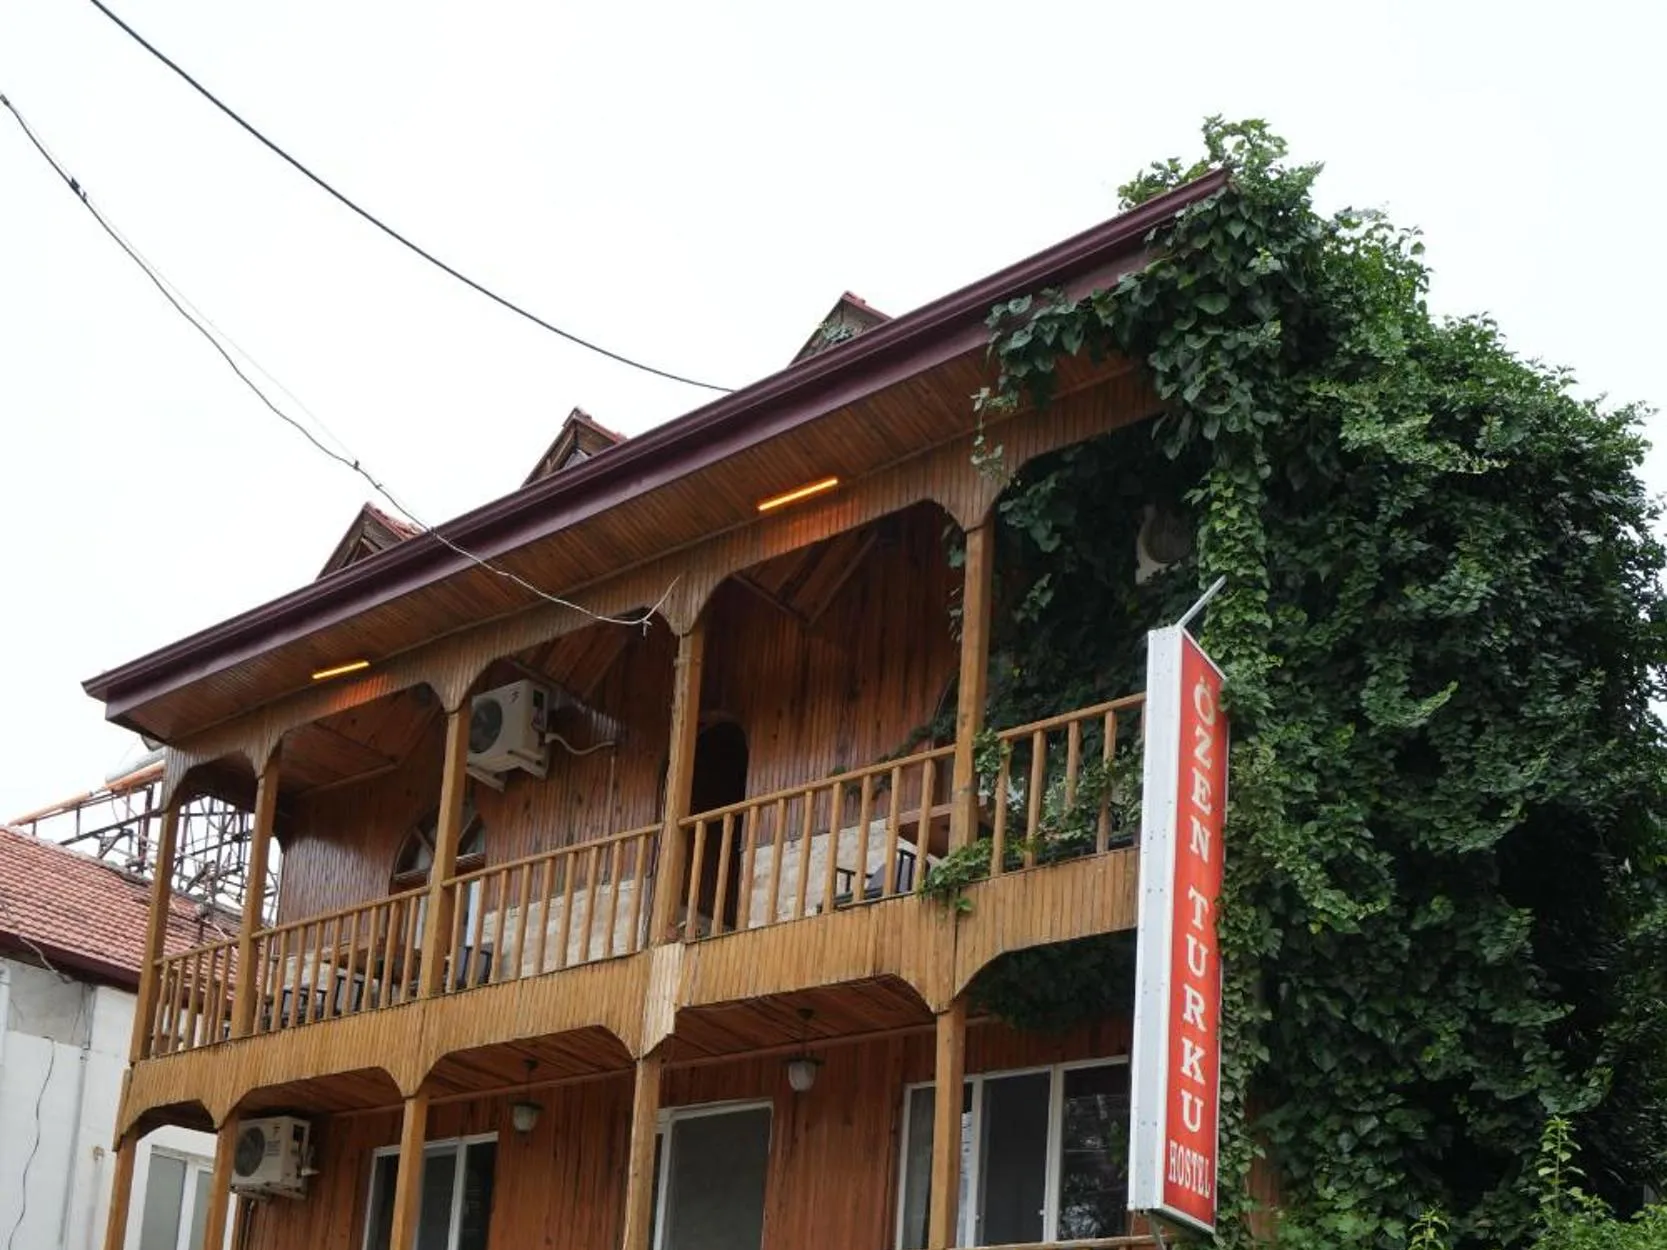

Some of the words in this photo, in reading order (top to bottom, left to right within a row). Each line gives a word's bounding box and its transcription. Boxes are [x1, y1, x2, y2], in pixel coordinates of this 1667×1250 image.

[1189, 675, 1217, 863] ÖZEN
[1180, 884, 1210, 1133] TURKU
[1168, 1139, 1211, 1200] HOSTEL
